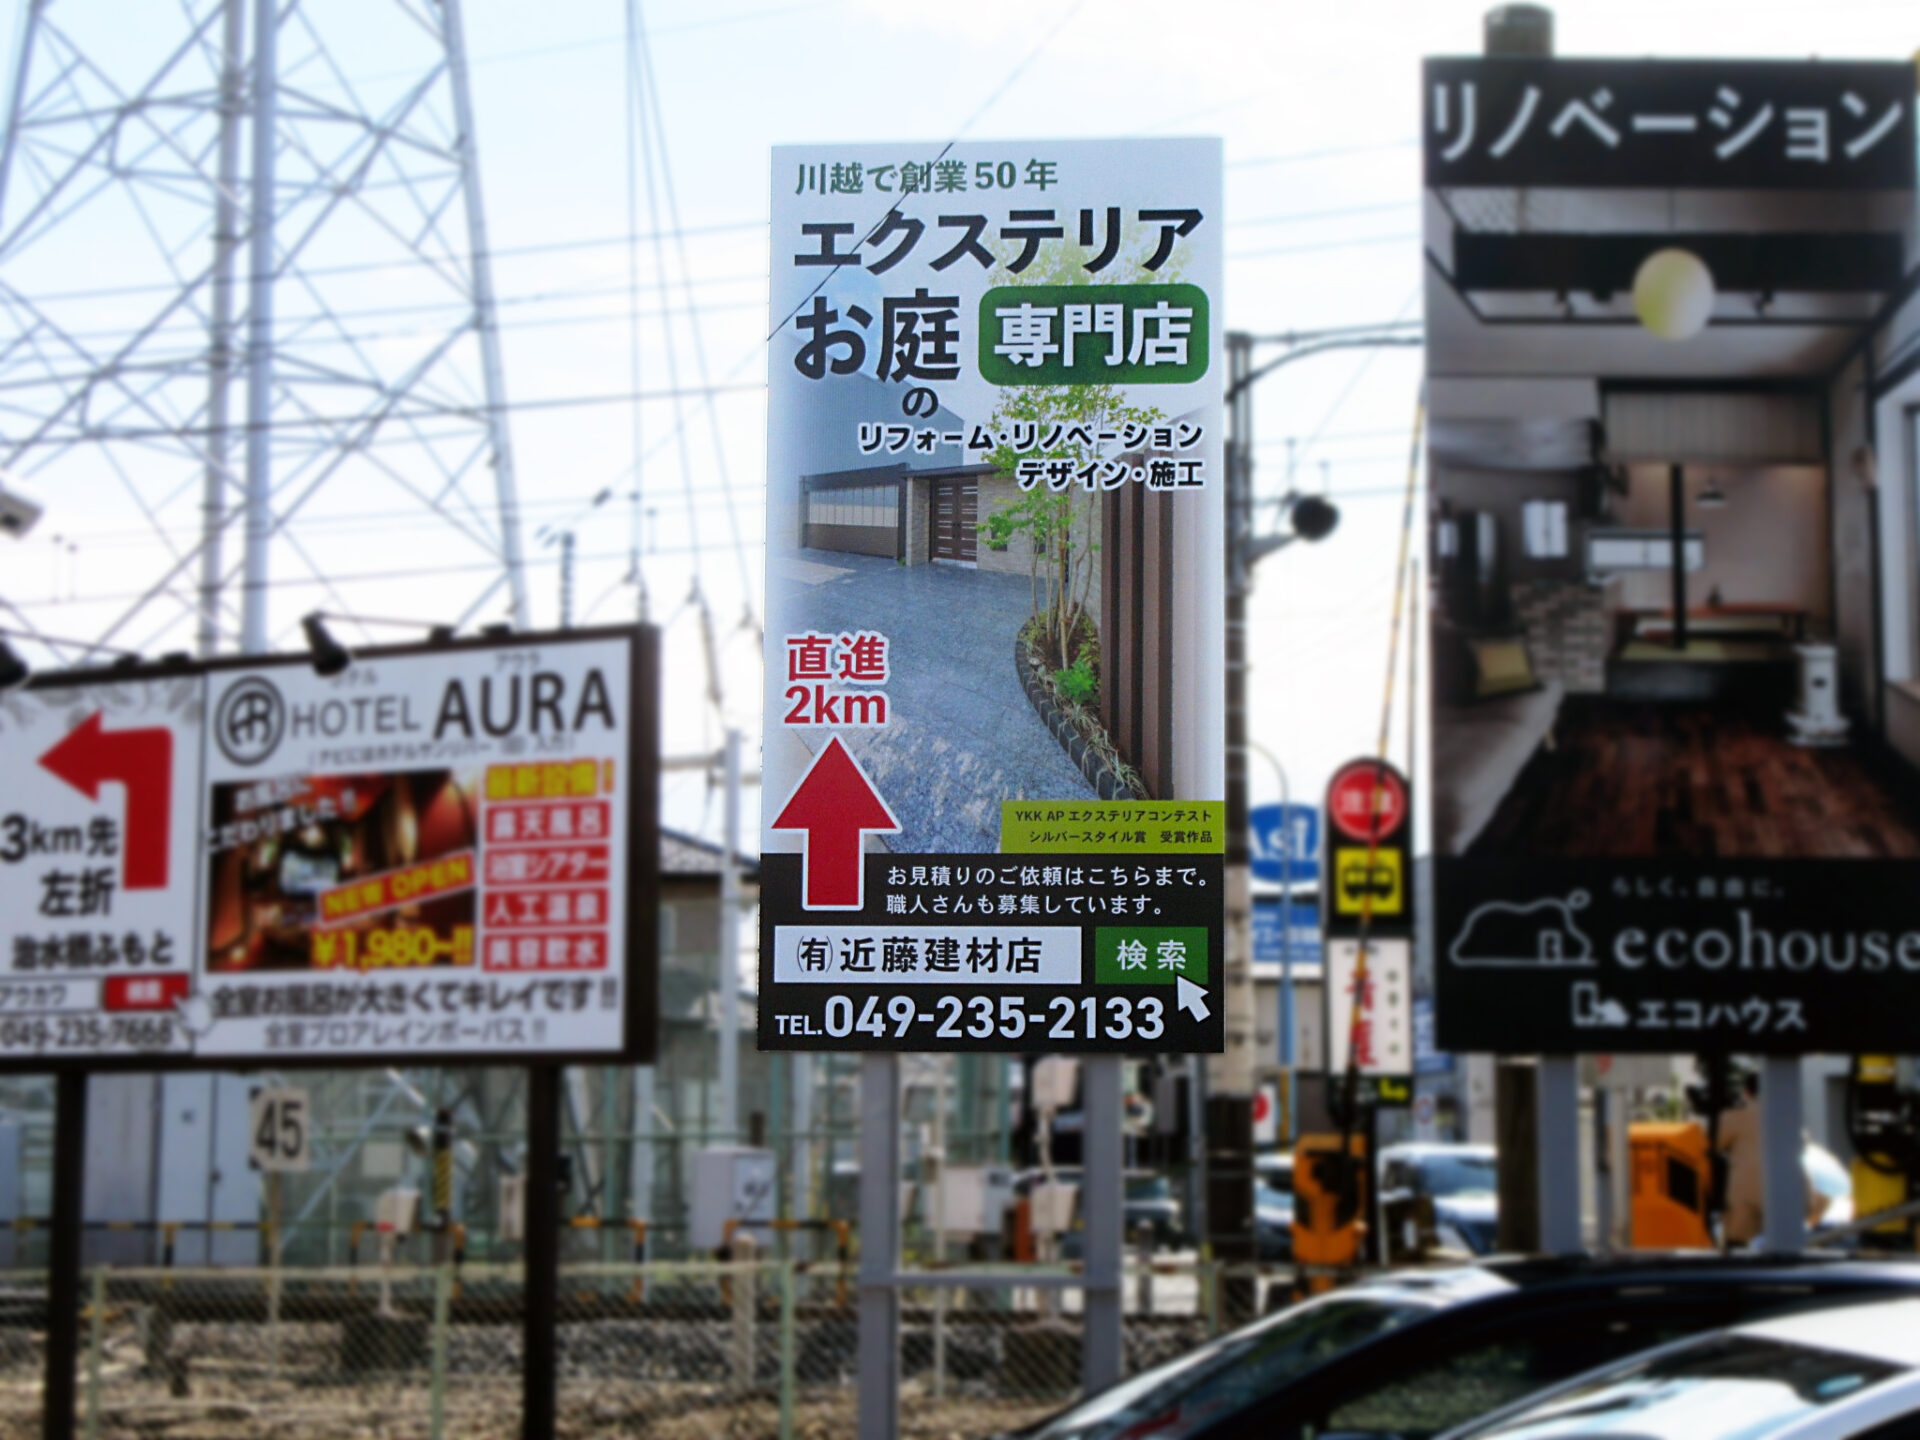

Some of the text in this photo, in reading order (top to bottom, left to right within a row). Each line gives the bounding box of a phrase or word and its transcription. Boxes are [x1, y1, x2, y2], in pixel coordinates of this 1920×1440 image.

[1434, 82, 1903, 162] リノベーション
[795, 158, 1059, 195] 川越で創業50年
[794, 206, 1205, 276] エクステリア
[794, 287, 1194, 384] お庭 専門店
[901, 386, 940, 419] の
[858, 423, 1204, 453] リフォーム・リノベーション
[1018, 460, 1205, 490] デザイン・施工
[786, 634, 887, 682] 直進
[290, 667, 617, 740] HOTEL AURA
[783, 685, 887, 725] 2km
[1015, 808, 1213, 823] YKK AP エクステリアコンテスト
[1, 813, 118, 862] 3km先
[1029, 829, 1213, 844] シルバースタイル賞 受賞作品
[39, 867, 115, 916] 左折
[324, 858, 470, 915] NEW OPEN
[886, 865, 1209, 887] お見積りのご依頼はこちらまで。
[886, 894, 1163, 916] 職人さんも募集しています。
[1116, 938, 1188, 972] 検索
[1612, 909, 1920, 971] ecohouse
[1637, 995, 1807, 1033] エコハウス
[257, 1095, 302, 1161] 45
